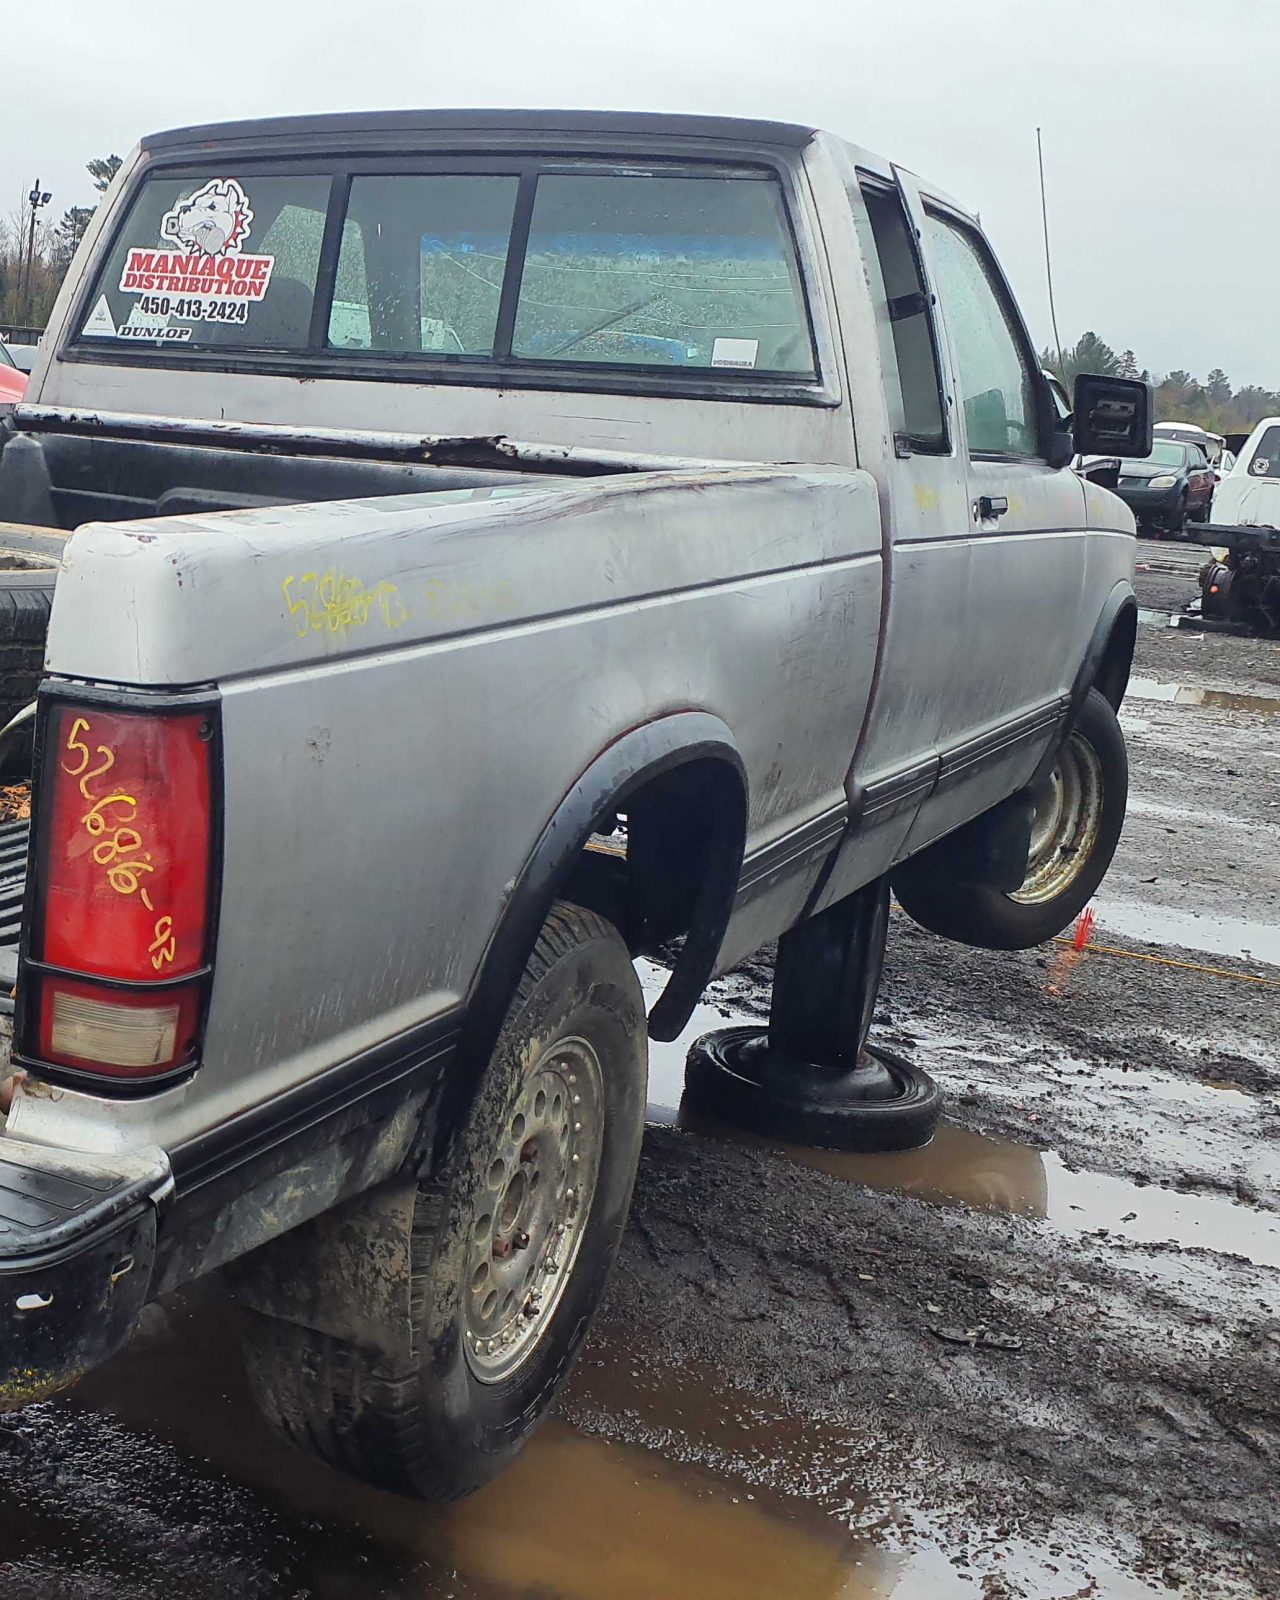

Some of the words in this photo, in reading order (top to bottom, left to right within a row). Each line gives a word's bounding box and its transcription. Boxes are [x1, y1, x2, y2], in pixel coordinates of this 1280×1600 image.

[128, 253, 270, 280] MANIAQUE
[124, 274, 264, 297] DISTRIBUTION
[141, 296, 246, 322] 450-413-2424
[120, 326, 190, 339] DUNLOP
